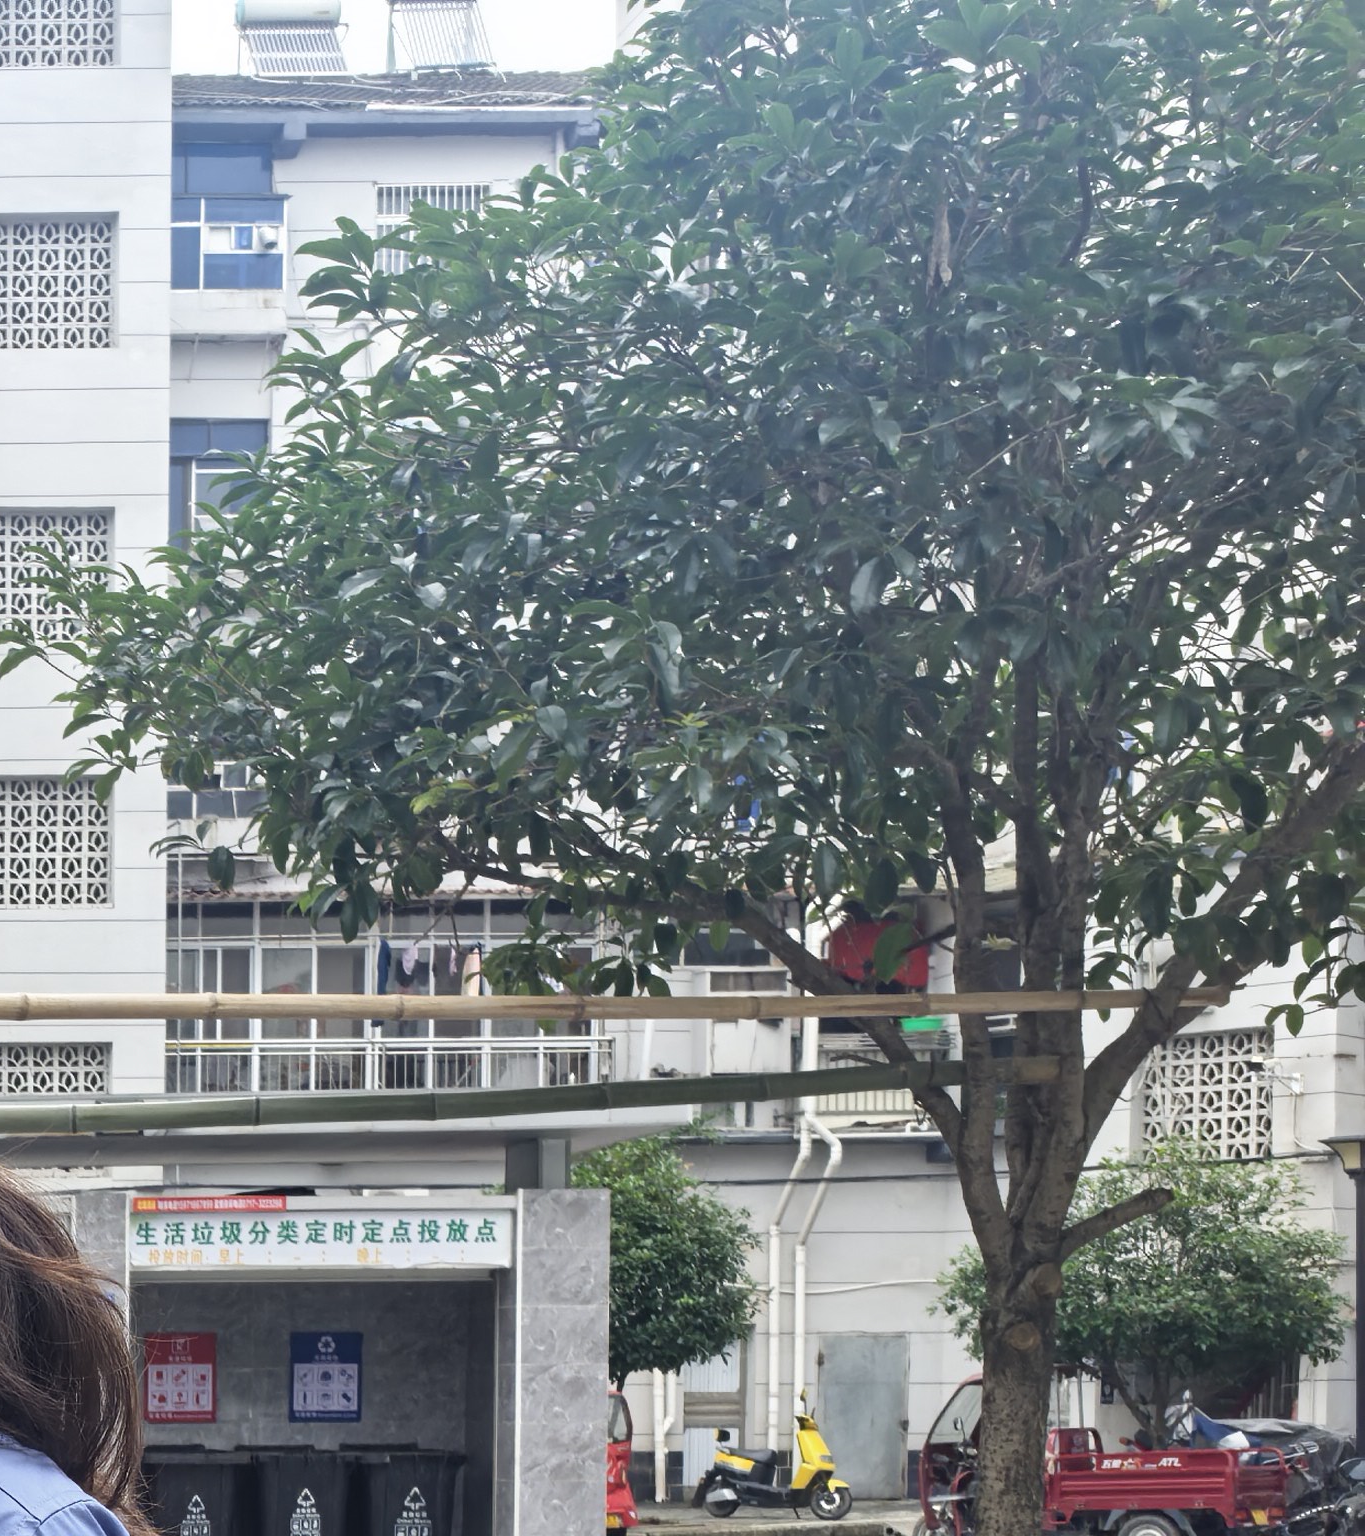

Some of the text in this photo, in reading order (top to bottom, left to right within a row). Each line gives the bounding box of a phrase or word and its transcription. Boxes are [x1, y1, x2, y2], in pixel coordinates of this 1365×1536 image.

[135, 1218, 497, 1246] 生活垃圾分类定时定点投放点
